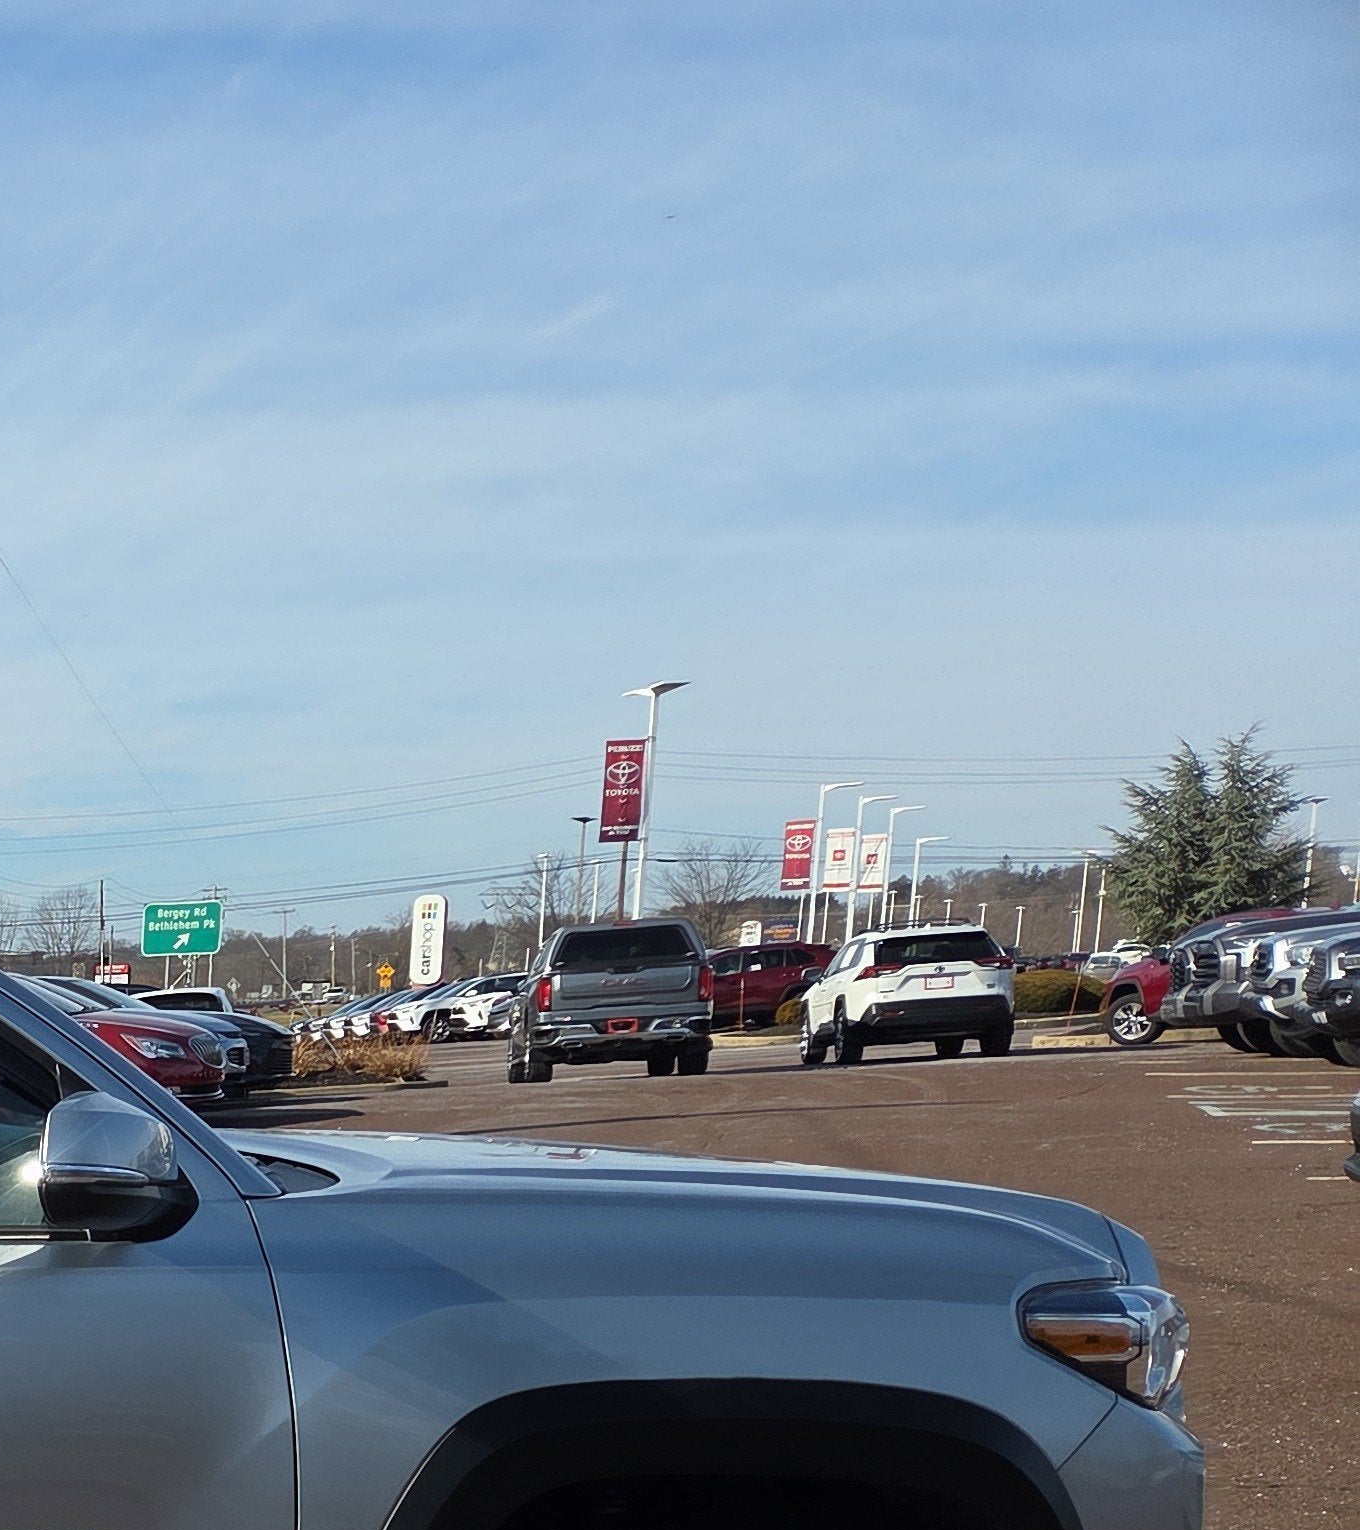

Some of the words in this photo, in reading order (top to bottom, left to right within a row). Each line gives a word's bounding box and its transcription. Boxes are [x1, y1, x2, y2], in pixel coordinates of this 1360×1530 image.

[605, 787, 640, 797] TOYOTA
[157, 907, 191, 920] Bergey
[193, 906, 207, 917] Rd
[148, 920, 200, 932] Bethlehem
[203, 918, 216, 930] Pk
[419, 922, 436, 976] carshop
